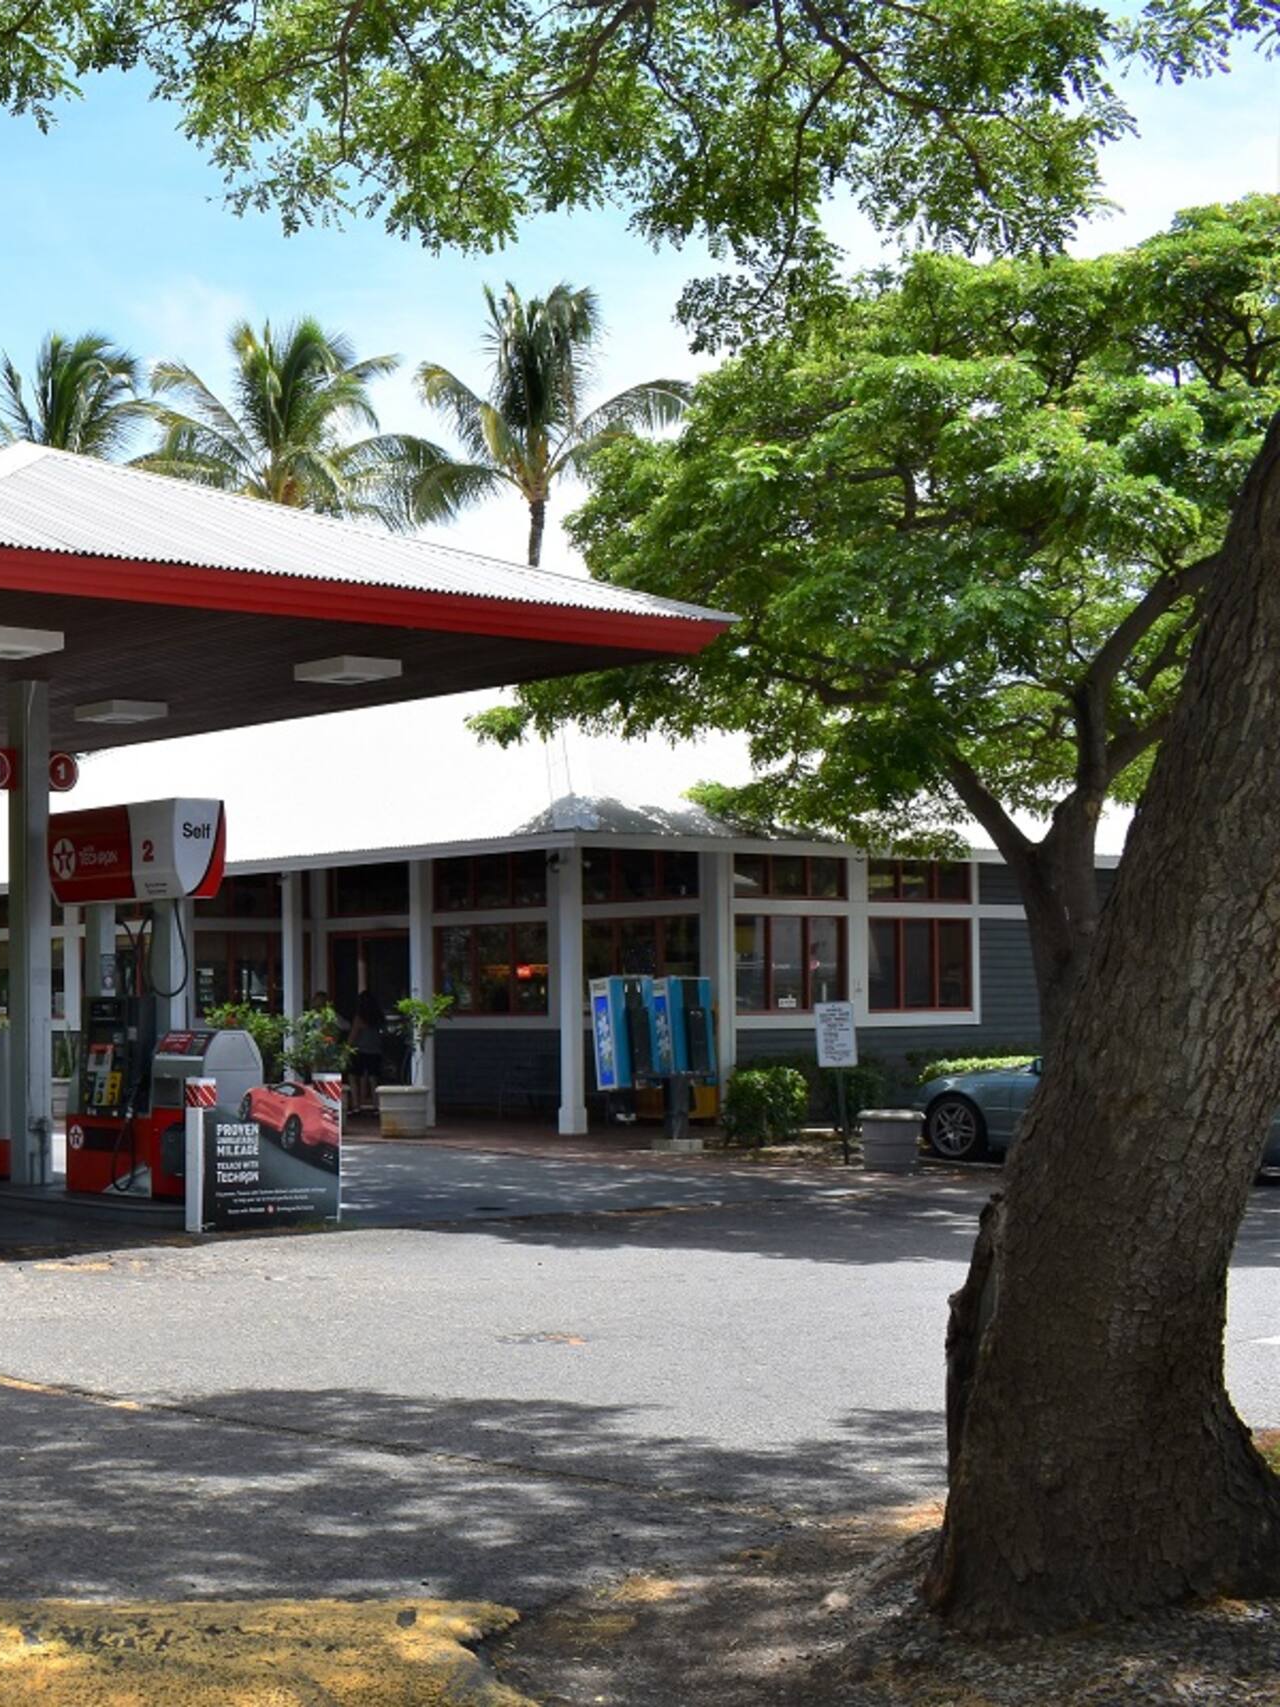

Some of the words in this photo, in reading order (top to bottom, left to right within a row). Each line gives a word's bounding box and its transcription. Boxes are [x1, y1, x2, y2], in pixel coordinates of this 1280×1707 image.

[57, 763, 66, 780] 1
[183, 822, 211, 839] Self
[142, 840, 155, 862] 2
[216, 1123, 260, 1136] PROVEN
[216, 1145, 260, 1157] MILEAGE
[216, 1170, 260, 1184] TECHRON
